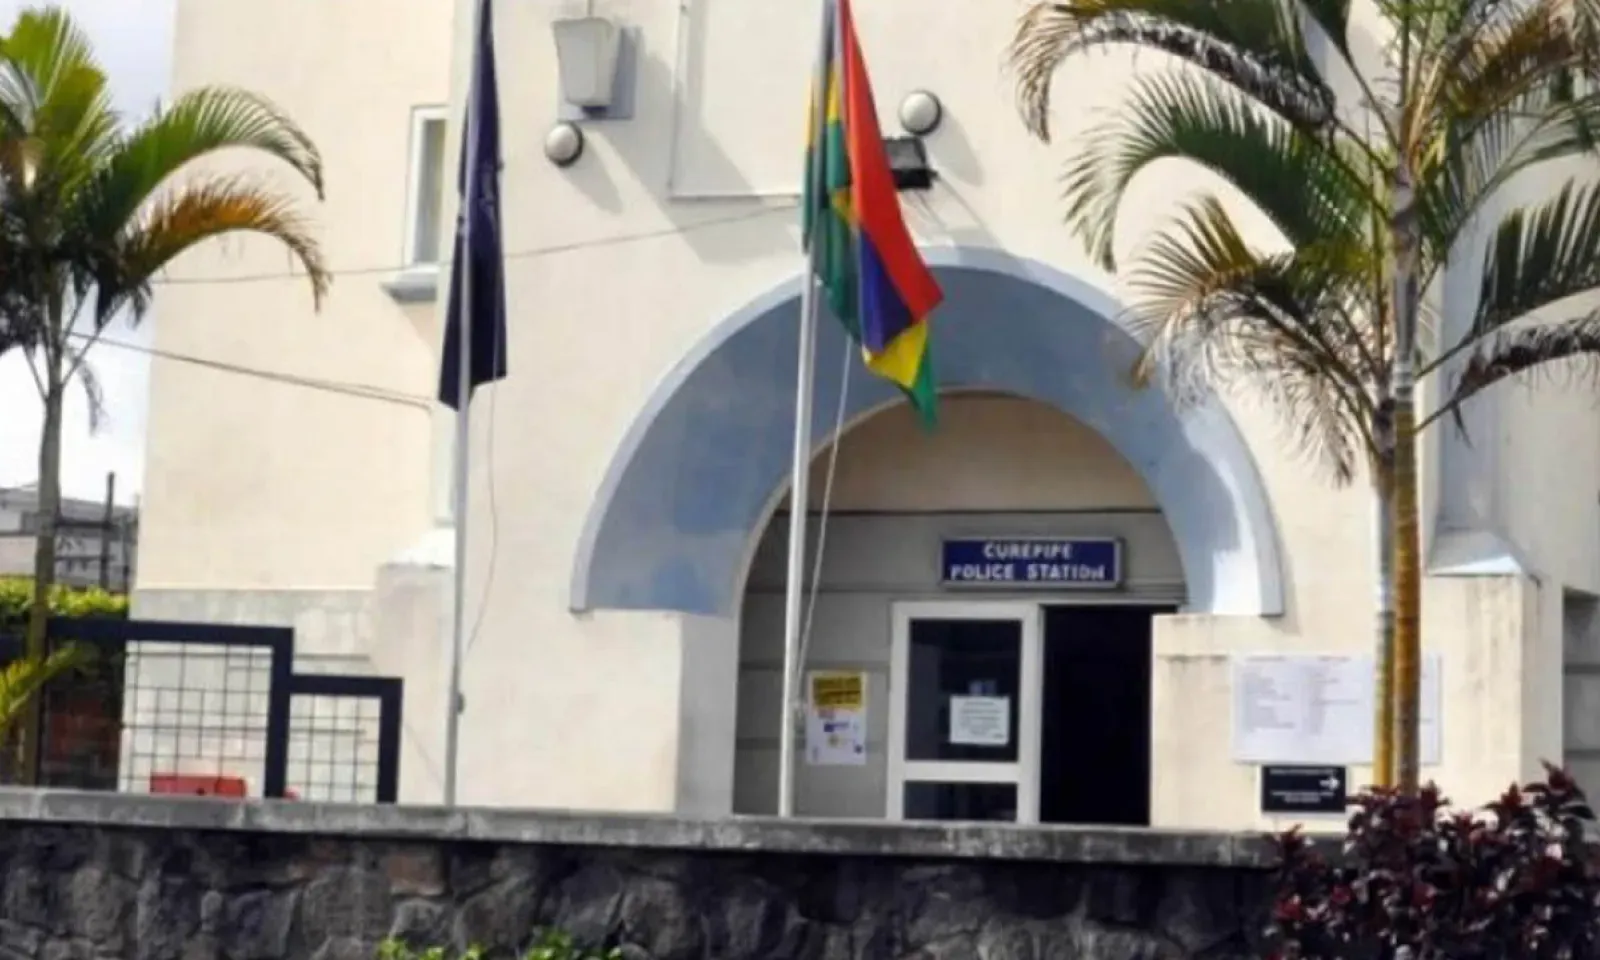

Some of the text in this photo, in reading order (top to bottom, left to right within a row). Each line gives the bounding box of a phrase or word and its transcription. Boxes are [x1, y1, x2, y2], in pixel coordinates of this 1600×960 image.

[983, 541, 1073, 560] CUREPIPE
[951, 563, 1106, 581] POLICE STATION
